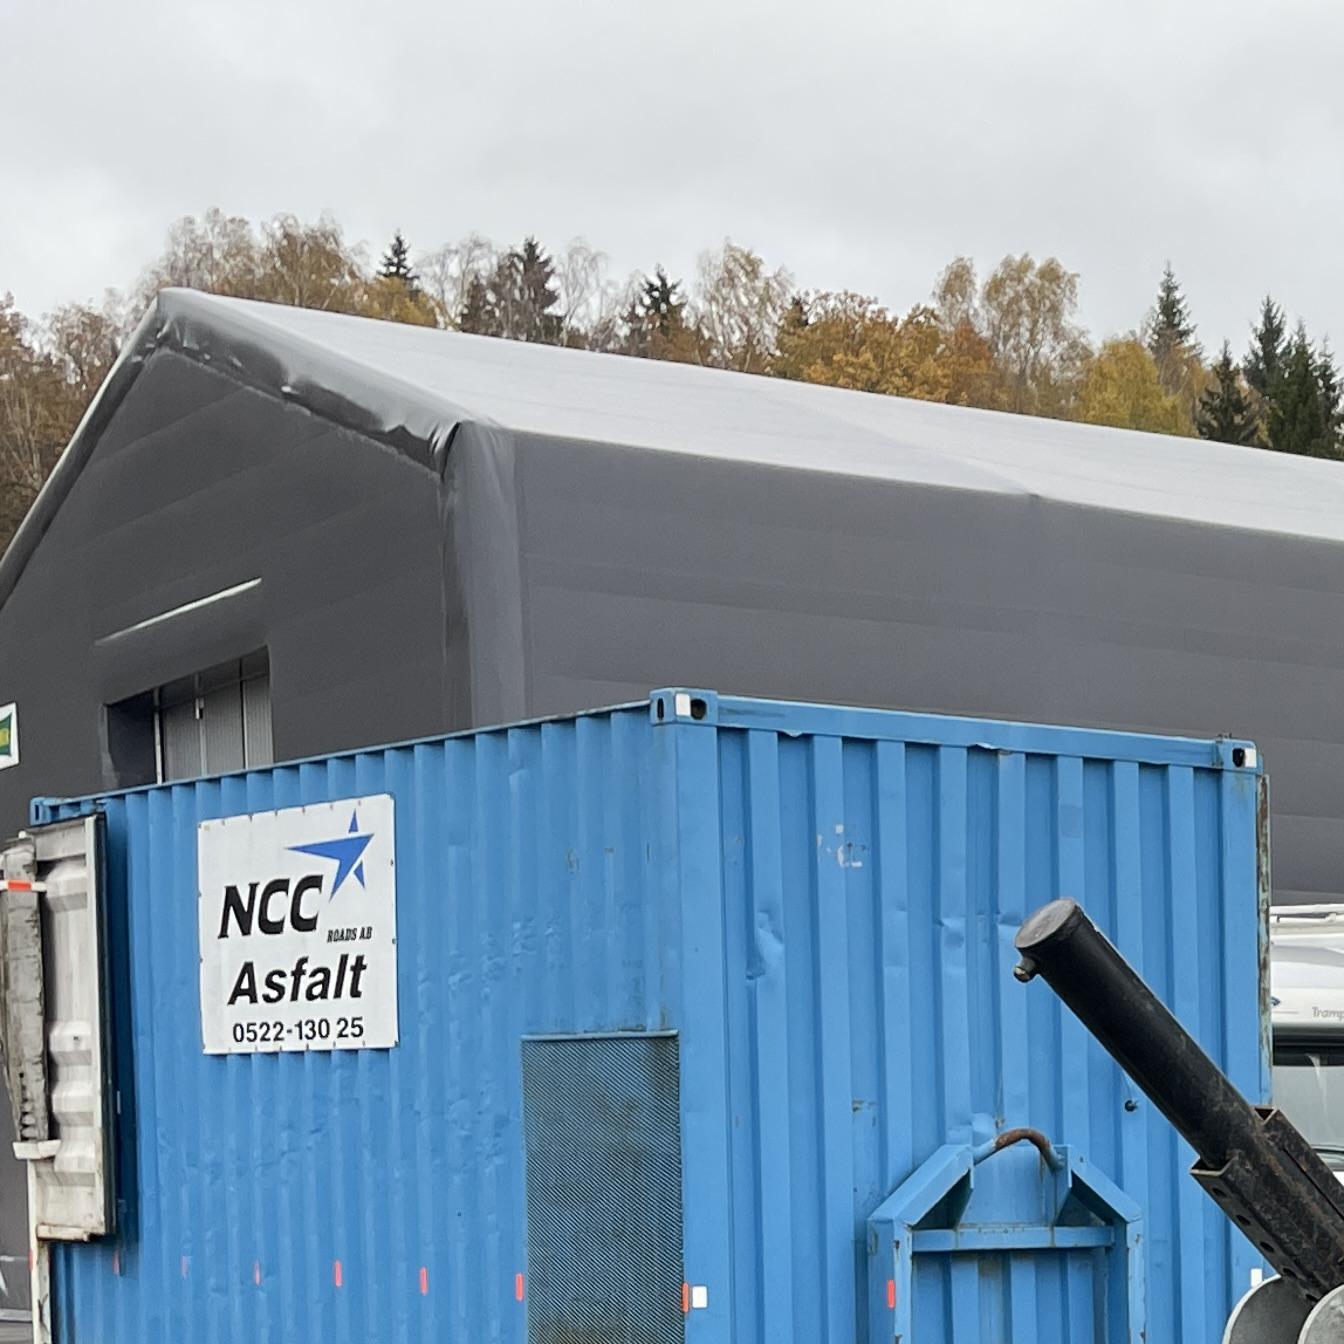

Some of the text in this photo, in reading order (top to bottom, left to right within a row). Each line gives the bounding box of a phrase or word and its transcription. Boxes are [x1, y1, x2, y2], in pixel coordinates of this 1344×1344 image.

[218, 874, 324, 940] NCC
[327, 926, 373, 943] ROADS AB
[227, 953, 368, 1006] Asfalt
[232, 1016, 364, 1043] 0522-130 25
